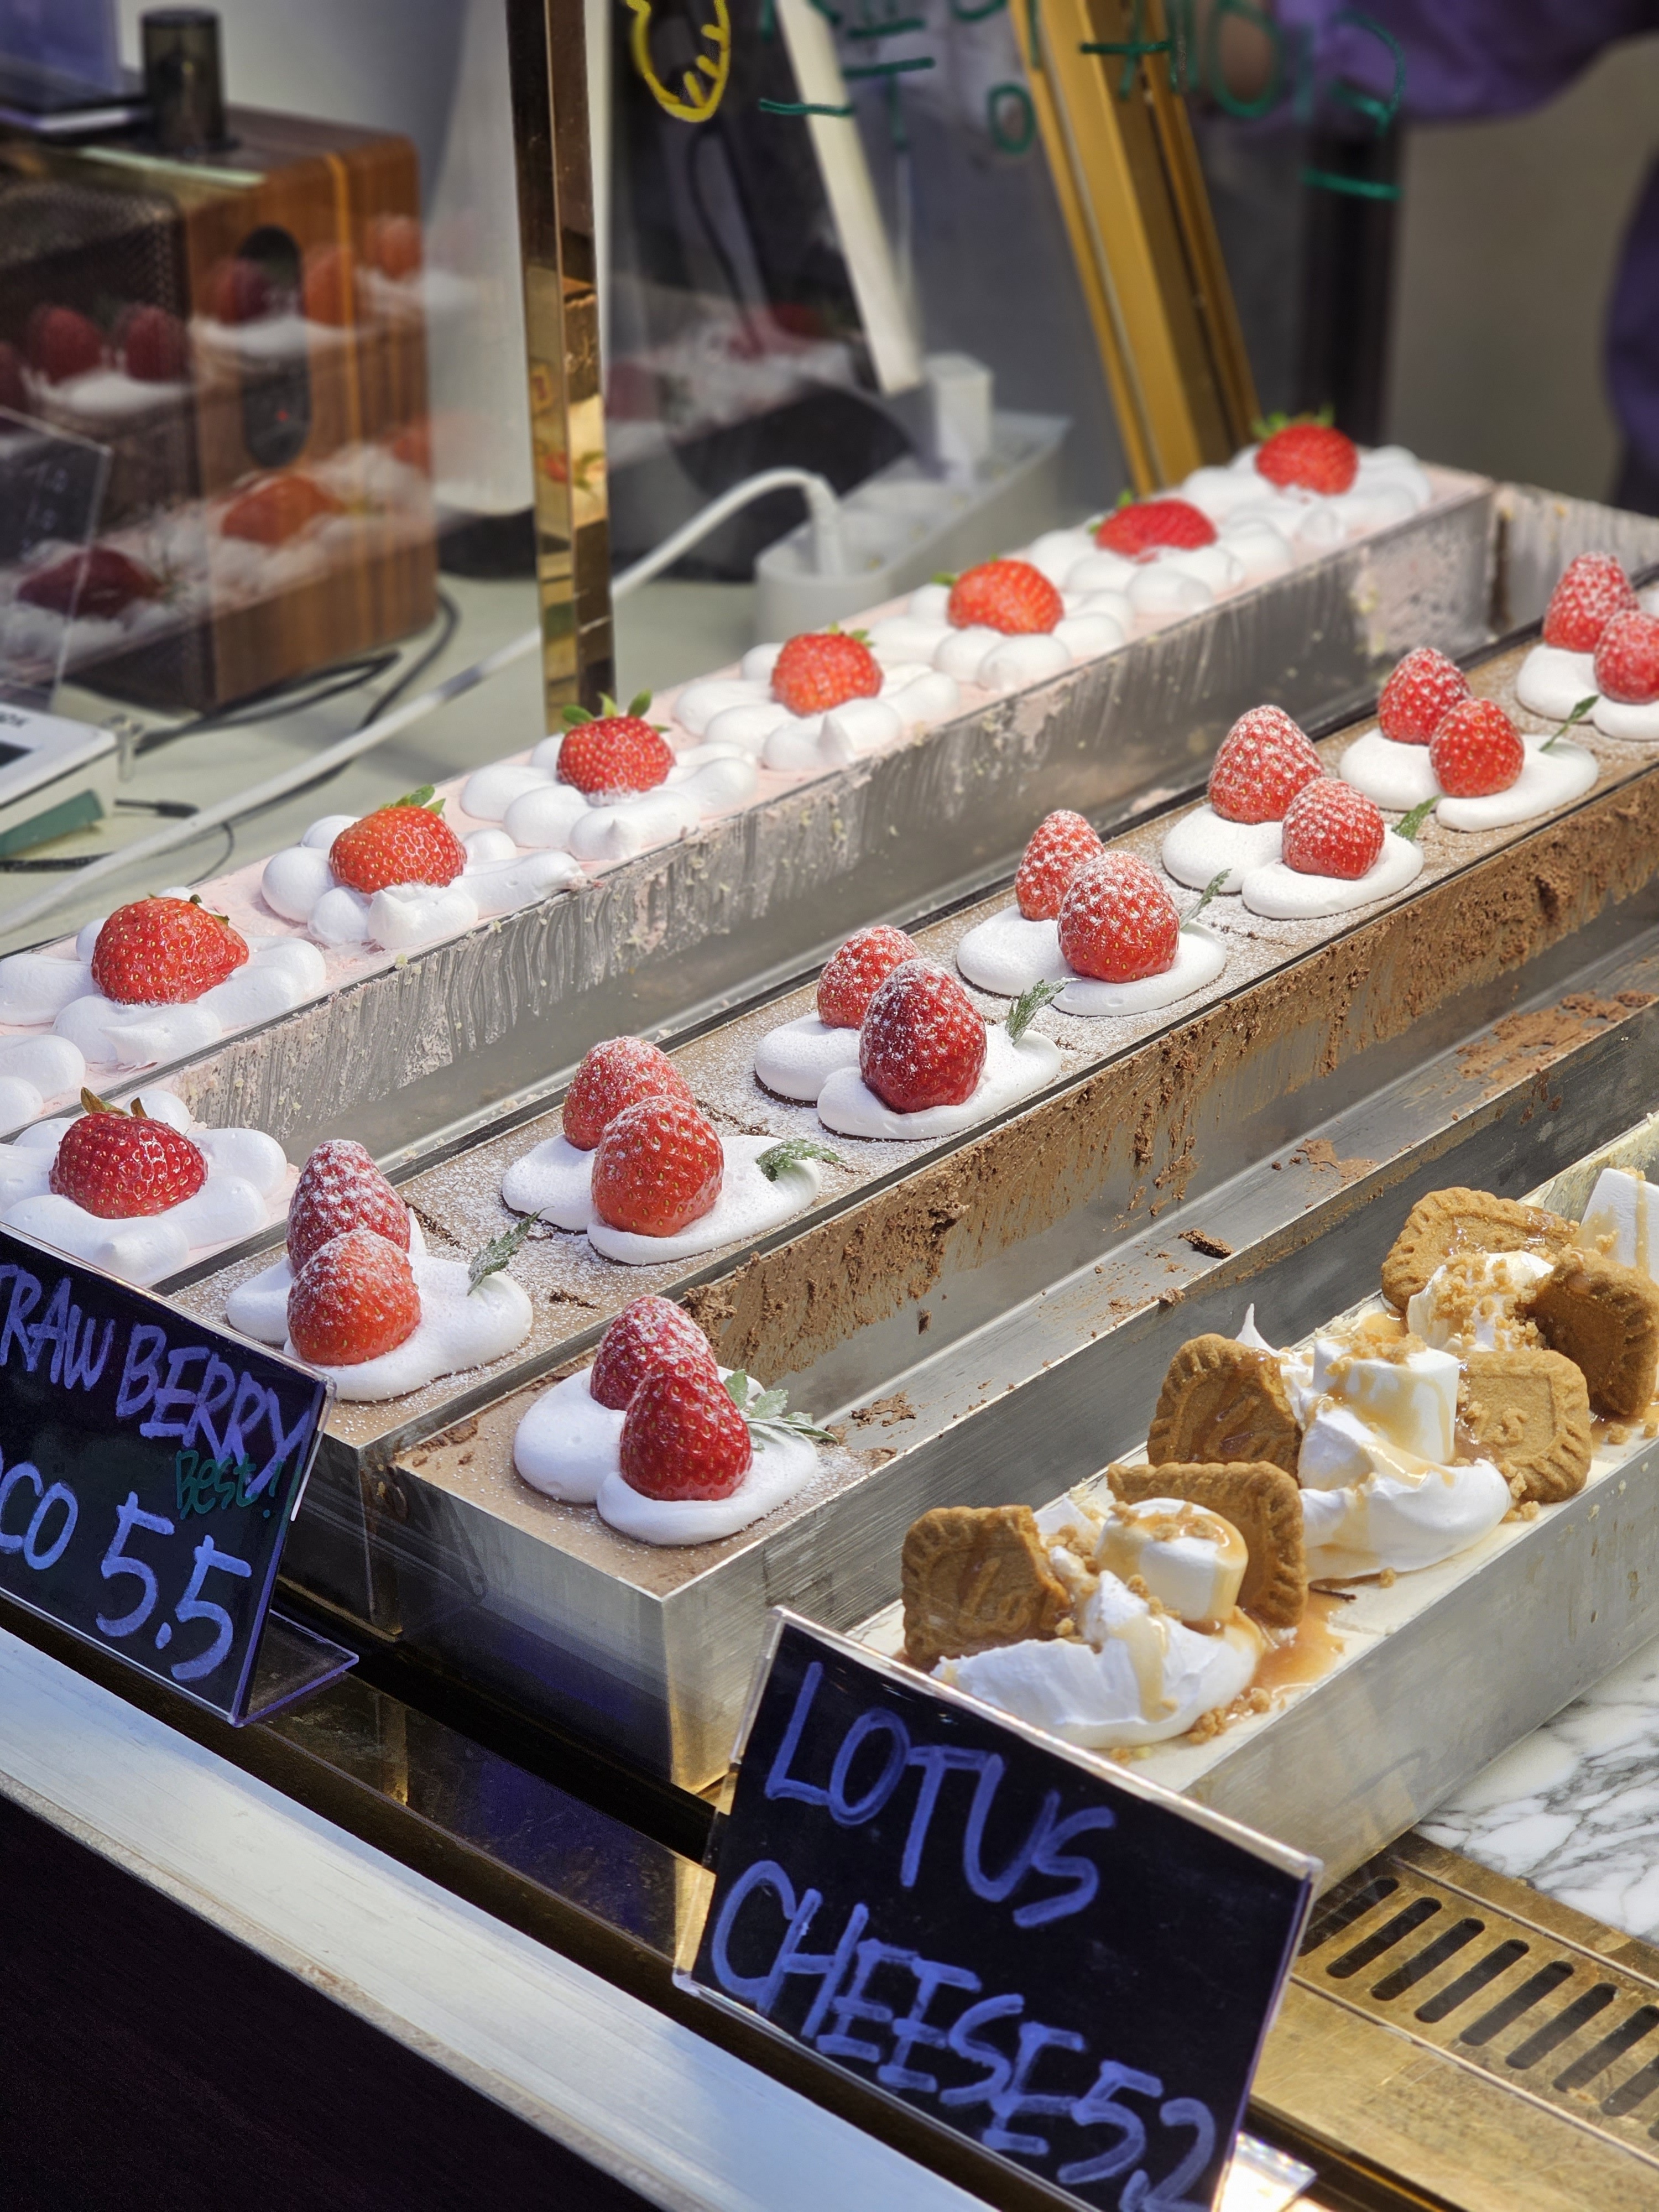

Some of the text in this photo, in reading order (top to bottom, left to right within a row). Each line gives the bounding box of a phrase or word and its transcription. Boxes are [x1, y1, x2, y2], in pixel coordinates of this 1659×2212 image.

[0, 1447, 252, 1681] CO 5.5
[765, 1662, 1114, 1928] LOTUS
[711, 1860, 1086, 2156] CHEESE
